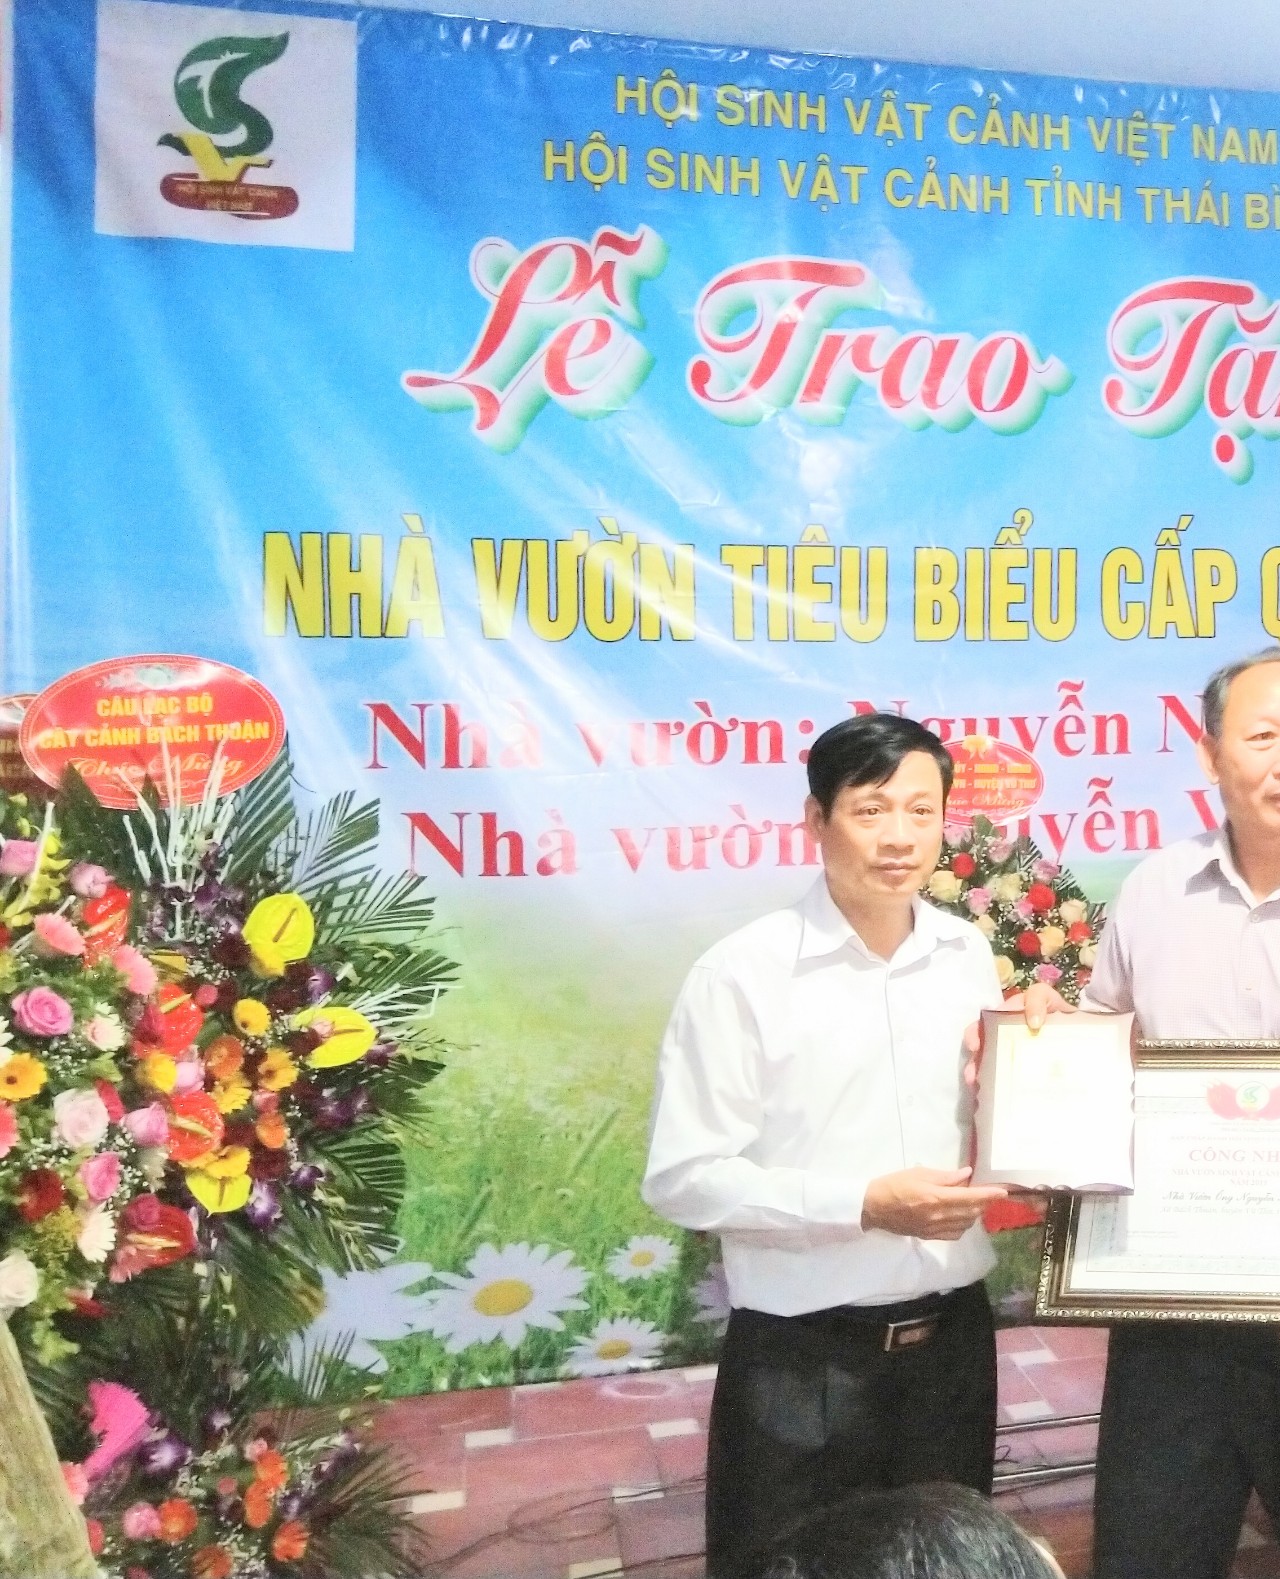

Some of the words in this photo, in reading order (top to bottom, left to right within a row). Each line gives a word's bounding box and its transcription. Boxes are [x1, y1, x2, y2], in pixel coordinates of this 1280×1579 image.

[615, 69, 699, 122] HỘI
[716, 85, 827, 132] SINH
[844, 89, 933, 148] VẬT
[948, 94, 1071, 152] CẢNH
[1087, 111, 1173, 166] VIỆT
[1192, 123, 1279, 166] NAM
[543, 132, 627, 192] HỘI
[645, 152, 760, 198] SINH
[779, 154, 869, 215] VẬT
[884, 156, 1010, 216] CẢNH
[1025, 164, 1121, 222] TỈNH
[1136, 179, 1231, 227] THÁI
[402, 222, 655, 442] Lễ
[686, 256, 1062, 422] Trao
[263, 513, 445, 639] NHÀ
[472, 516, 696, 643] VƯỜN
[721, 524, 888, 643] TIÊU
[914, 507, 1077, 642] BIỂU
[1101, 514, 1238, 640] CẤP
[85, 722, 141, 747] CẢNH
[96, 695, 138, 718] CÂU
[186, 692, 213, 716] BỘ
[364, 701, 543, 770] Nhà
[401, 807, 579, 877] Nhà
[611, 804, 823, 873] vườn
[1188, 1146, 1246, 1162] CÔNG
